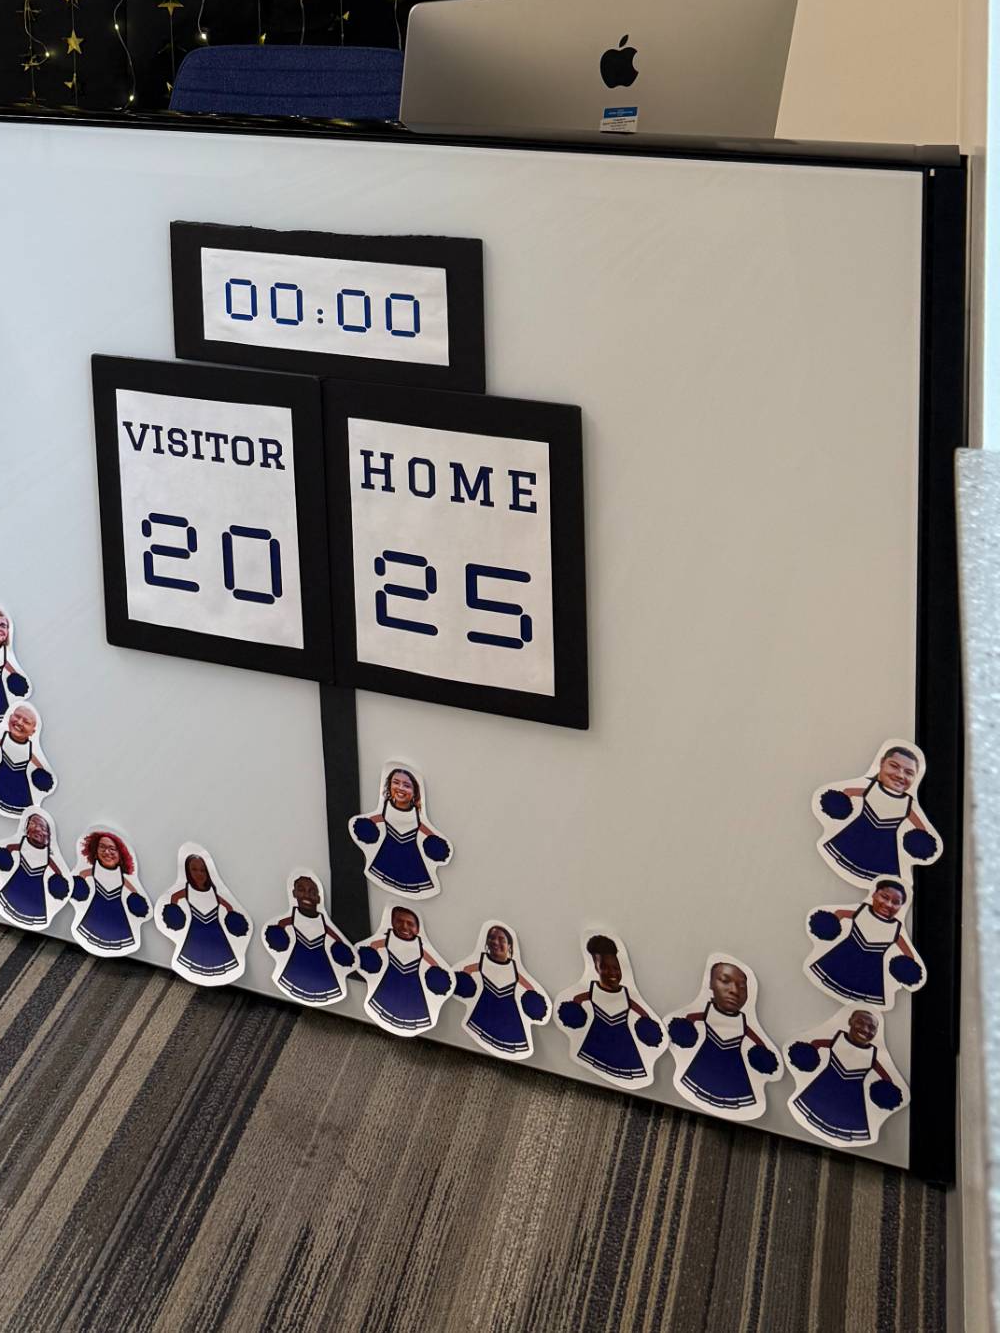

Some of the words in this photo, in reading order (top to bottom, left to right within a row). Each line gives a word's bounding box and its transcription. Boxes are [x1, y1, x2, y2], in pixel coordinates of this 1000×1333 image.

[225, 278, 420, 338] 00:00
[122, 420, 286, 470] VISITOR
[359, 449, 538, 514] HOME
[141, 512, 283, 605] 20
[374, 550, 533, 649] 25
